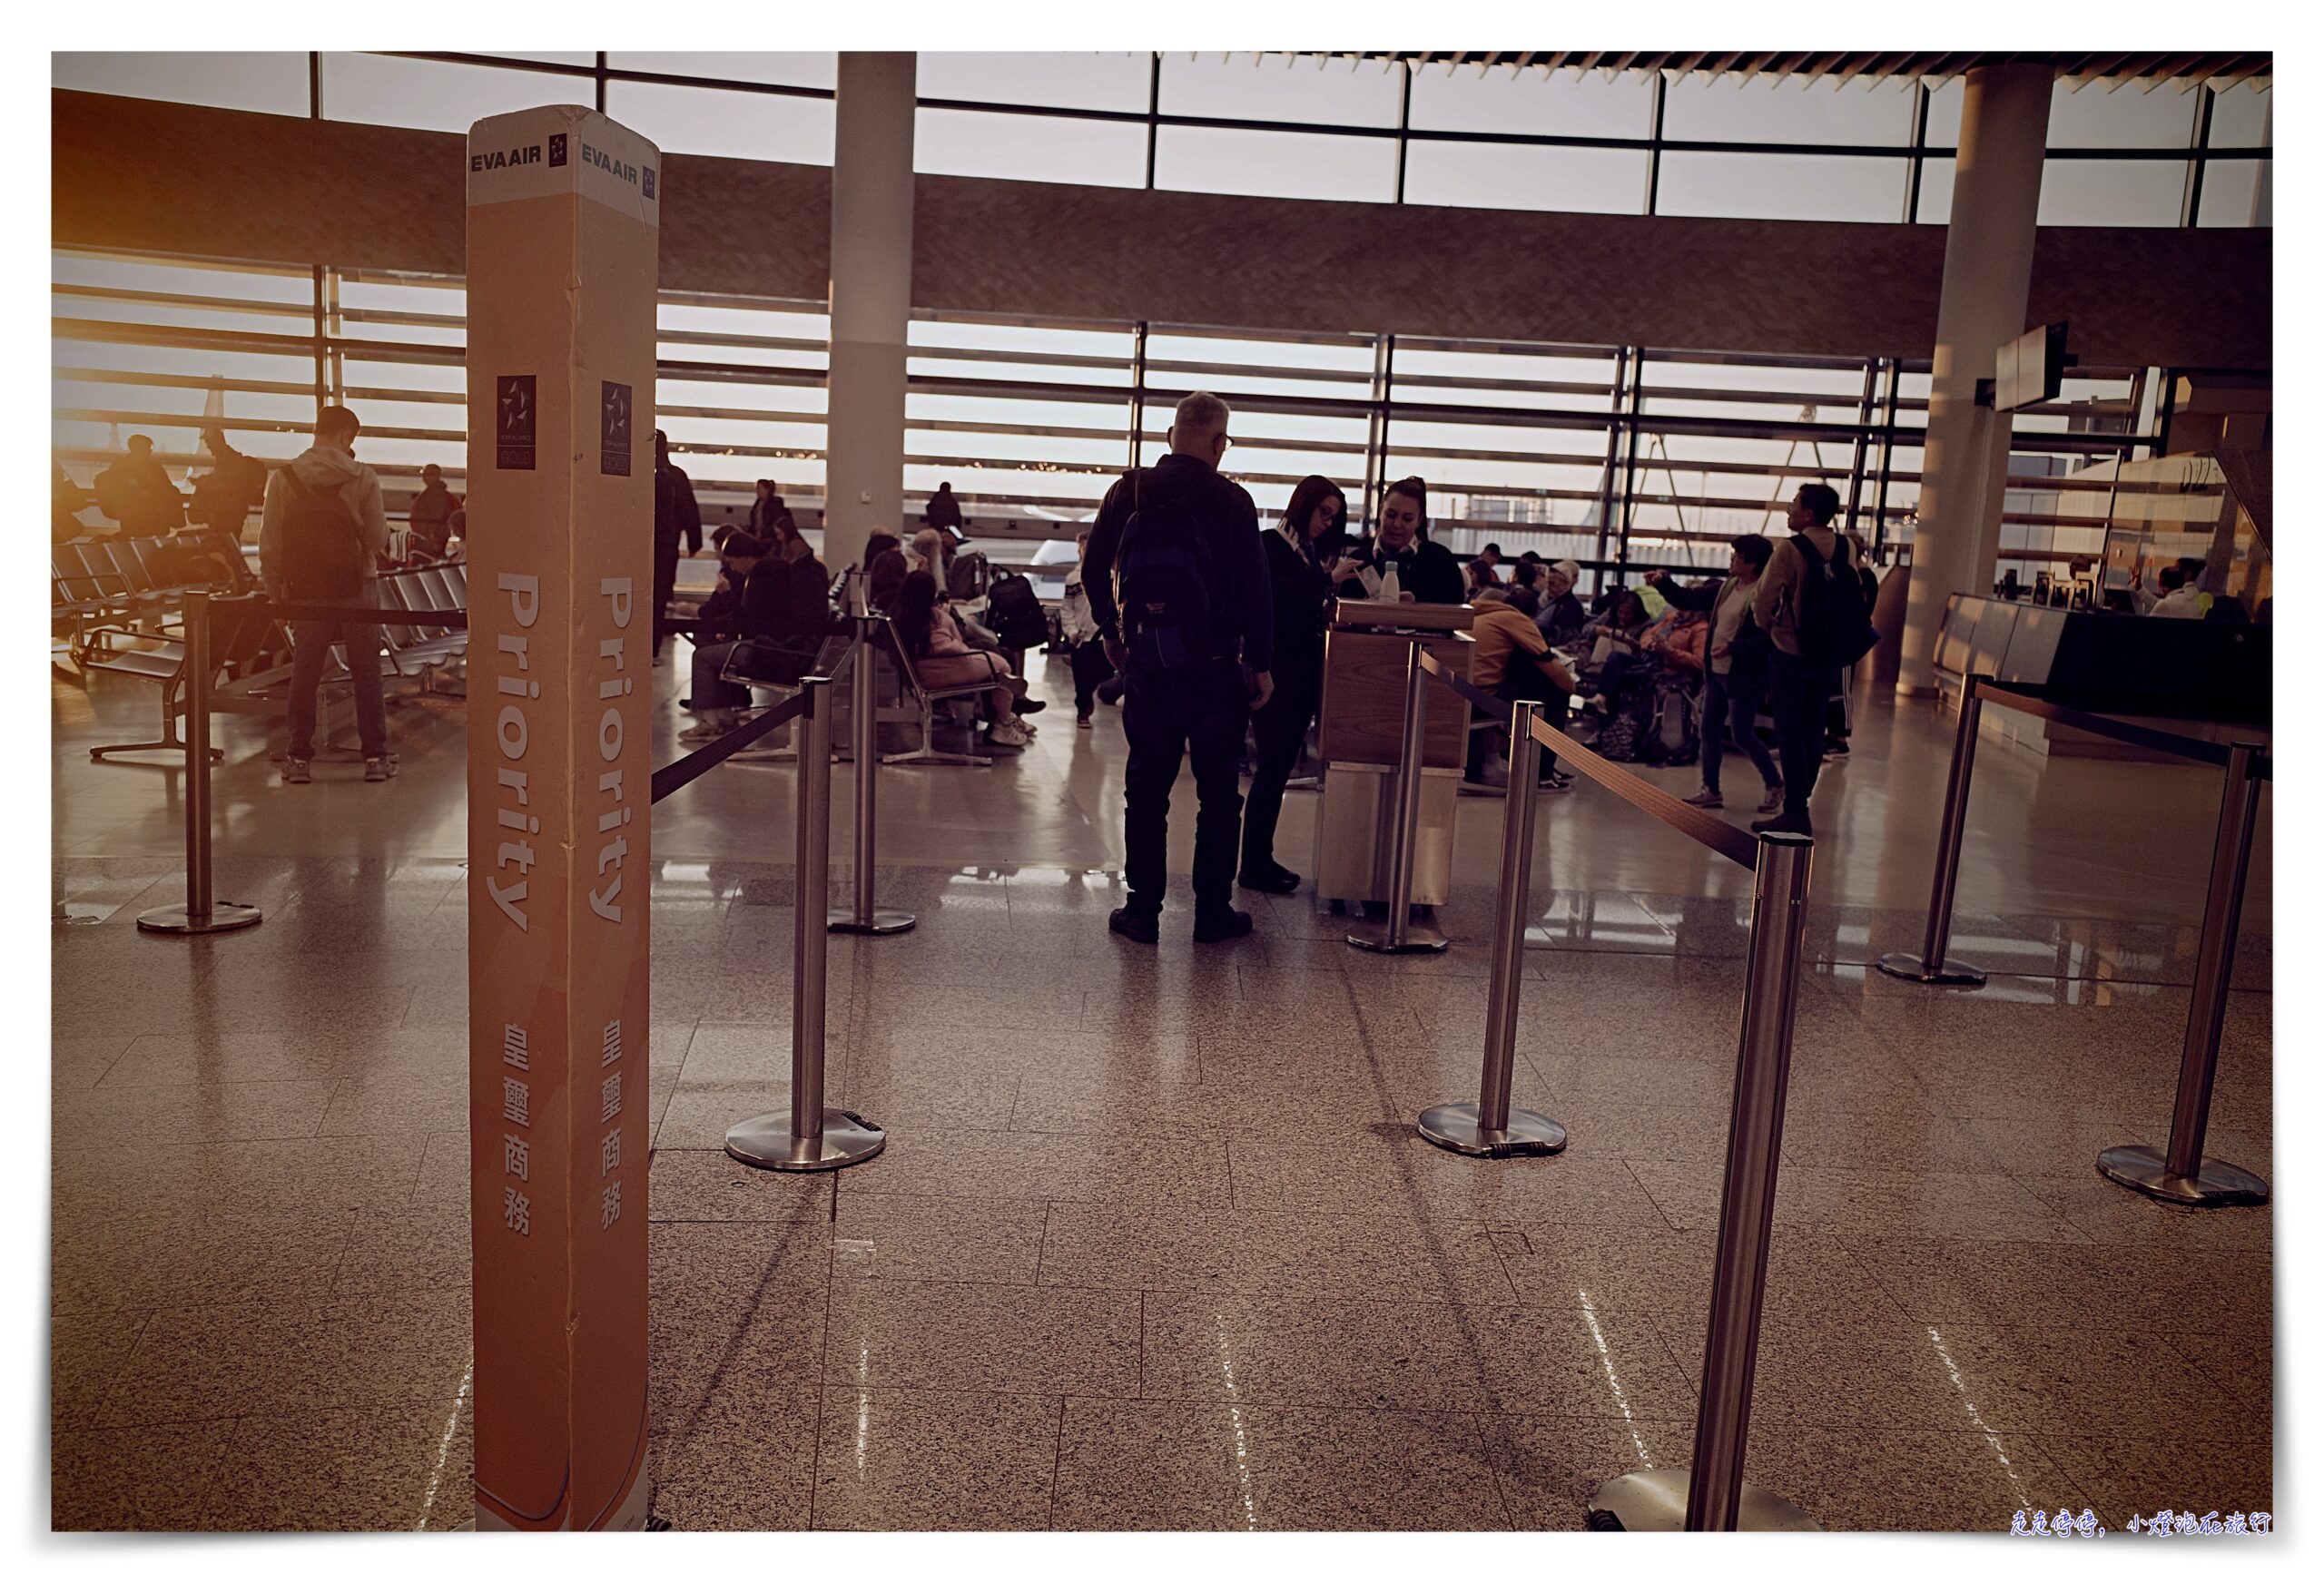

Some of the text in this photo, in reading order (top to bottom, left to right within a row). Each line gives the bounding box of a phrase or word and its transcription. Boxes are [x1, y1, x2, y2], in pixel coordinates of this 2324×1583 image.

[487, 572, 540, 933] Priority
[589, 577, 633, 924] Priority
[503, 1022, 530, 1236] 皇璽商務
[601, 1018, 623, 1231] 皇璽商務
